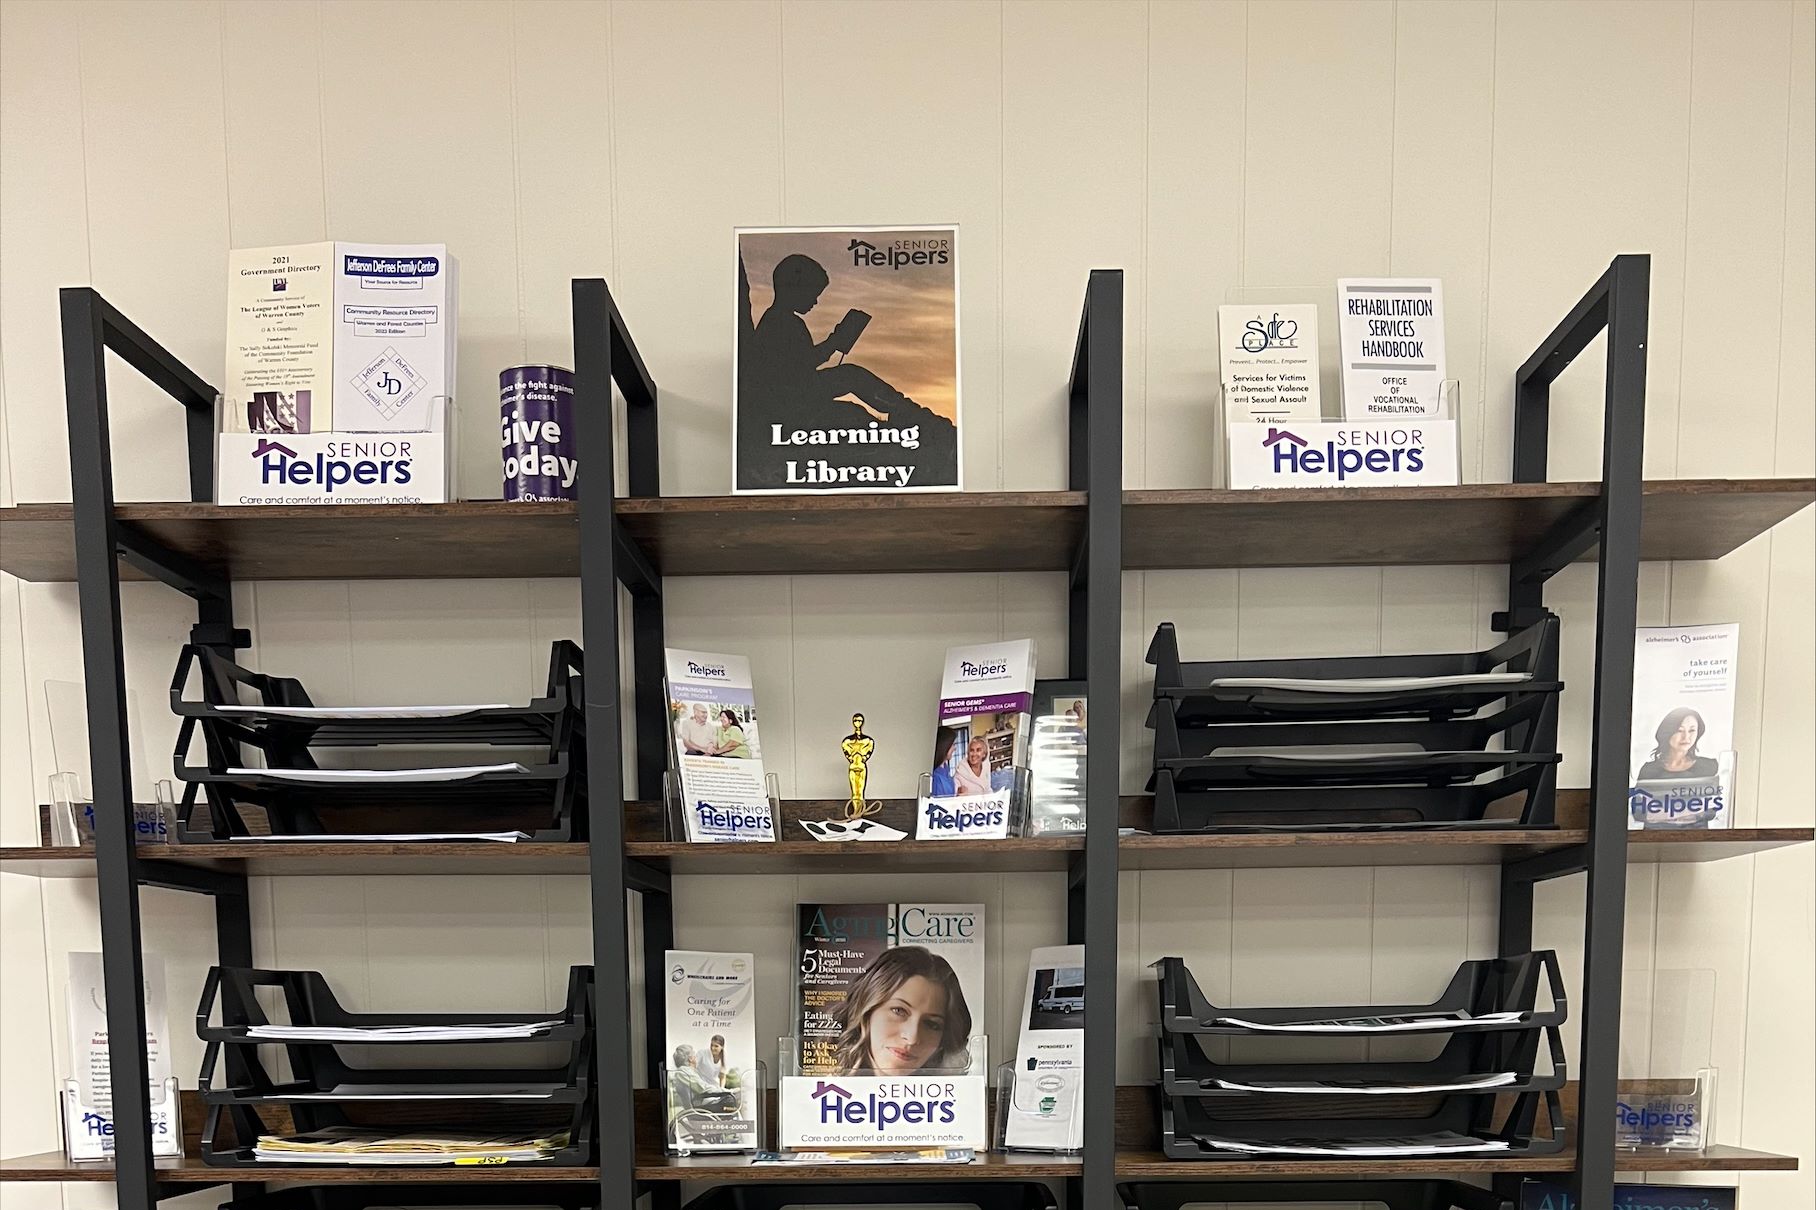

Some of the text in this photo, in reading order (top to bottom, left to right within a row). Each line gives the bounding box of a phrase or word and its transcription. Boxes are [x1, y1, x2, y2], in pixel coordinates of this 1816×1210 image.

[895, 239, 948, 250] SENIOR
[272, 256, 290, 264] 2021
[854, 247, 949, 270] Helpers
[241, 264, 321, 276] Government Directory
[347, 257, 436, 276] Jefferson DeFrees Family Center
[252, 305, 272, 313] League
[346, 307, 435, 317] Community Resource Directory
[1348, 298, 1433, 318] REHABILITATION
[1368, 319, 1415, 338] SERVICES
[1362, 339, 1424, 359] HANDBOOK
[361, 357, 386, 380] Jefferson
[1232, 373, 1306, 382] Services for Victims
[1382, 377, 1408, 386] OFFICE
[528, 380, 548, 390] fight
[1231, 384, 1309, 393] of Domestic Violence
[526, 391, 558, 402] disease.
[1390, 387, 1400, 395] OF
[1251, 395, 1307, 404] Sexual Assault
[1373, 396, 1419, 405] VOCATIONAL
[1368, 404, 1426, 414] REHABILITATION
[501, 410, 561, 449] Give
[771, 421, 920, 450] Learning
[1338, 429, 1423, 446] SENIOR
[327, 442, 411, 458] SENIOR
[503, 444, 578, 489] oday
[1273, 441, 1425, 481] Helpers
[262, 452, 413, 493] Helpers
[785, 460, 915, 487] Library
[239, 495, 423, 505] Care and comfort at a moment's notice.
[1645, 635, 1680, 643] alzheimer's
[1689, 658, 1708, 667] take
[690, 664, 726, 677] Helpers
[962, 664, 1007, 678] Helpers
[1683, 667, 1728, 679] of yourself
[943, 701, 1017, 713] ALZHEIMER'S DEMENTIA CARE
[944, 700, 965, 708] SENIOR
[1671, 785, 1724, 797] SENIOR
[730, 804, 770, 815] SENIOR
[961, 800, 1004, 812] SENIOR
[1630, 794, 1724, 818] Helpers
[701, 809, 772, 831] Helpers
[927, 809, 1003, 832] Helpers
[804, 906, 973, 950] Aging Care
[801, 948, 865, 975] 5 Must-Have
[818, 957, 842, 967] Legal
[818, 965, 867, 975] Documents
[803, 973, 814, 981] for
[687, 996, 730, 1009] Caring for
[687, 1007, 736, 1017] One Patient
[804, 1011, 833, 1021] Eating
[692, 1019, 702, 1028] at
[710, 1018, 732, 1028] Time
[803, 1019, 843, 1030] for ZZZs
[803, 1041, 839, 1051] It's Okay
[803, 1049, 830, 1057] to Ask
[803, 1056, 838, 1066] for Help
[1038, 1058, 1073, 1067] pennsylvania
[878, 1083, 955, 1098] SENIOR
[820, 1093, 956, 1131] Helpers
[801, 1134, 823, 1142] Care
[823, 1134, 841, 1142] and
[842, 1134, 875, 1142] comfort
[876, 1134, 885, 1142] at
[895, 1134, 936, 1142] moment's
[937, 1134, 966, 1142] notice.
